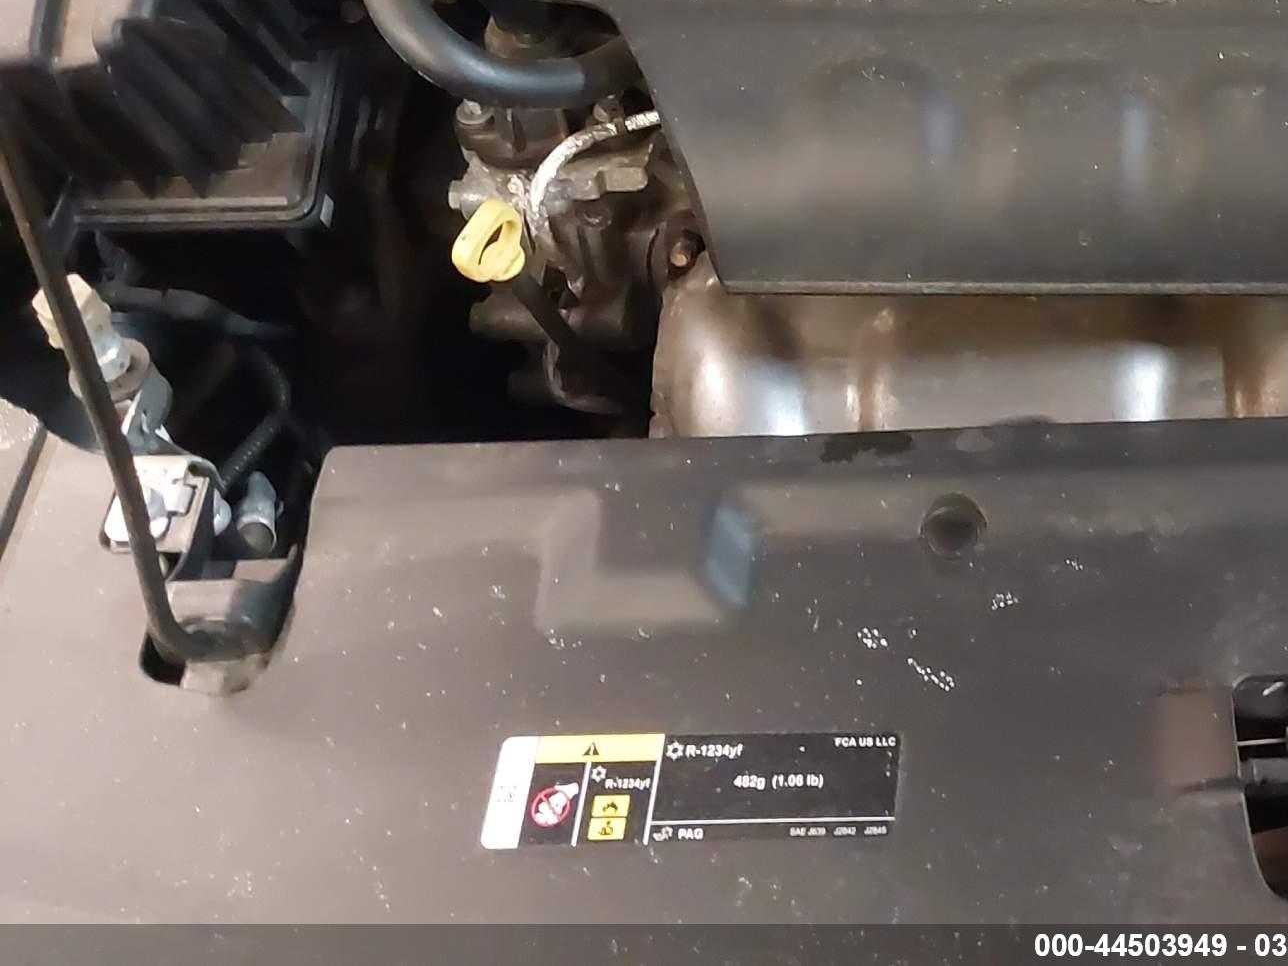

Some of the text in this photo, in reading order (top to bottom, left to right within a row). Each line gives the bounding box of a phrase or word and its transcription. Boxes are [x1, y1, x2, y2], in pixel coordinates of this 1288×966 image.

[834, 736, 896, 747] FCA US LLC
[686, 744, 743, 759] R-1234yf
[734, 775, 766, 790] 482g
[807, 774, 824, 788] lb)
[677, 828, 704, 840] PAG
[790, 827, 806, 837] SAE
